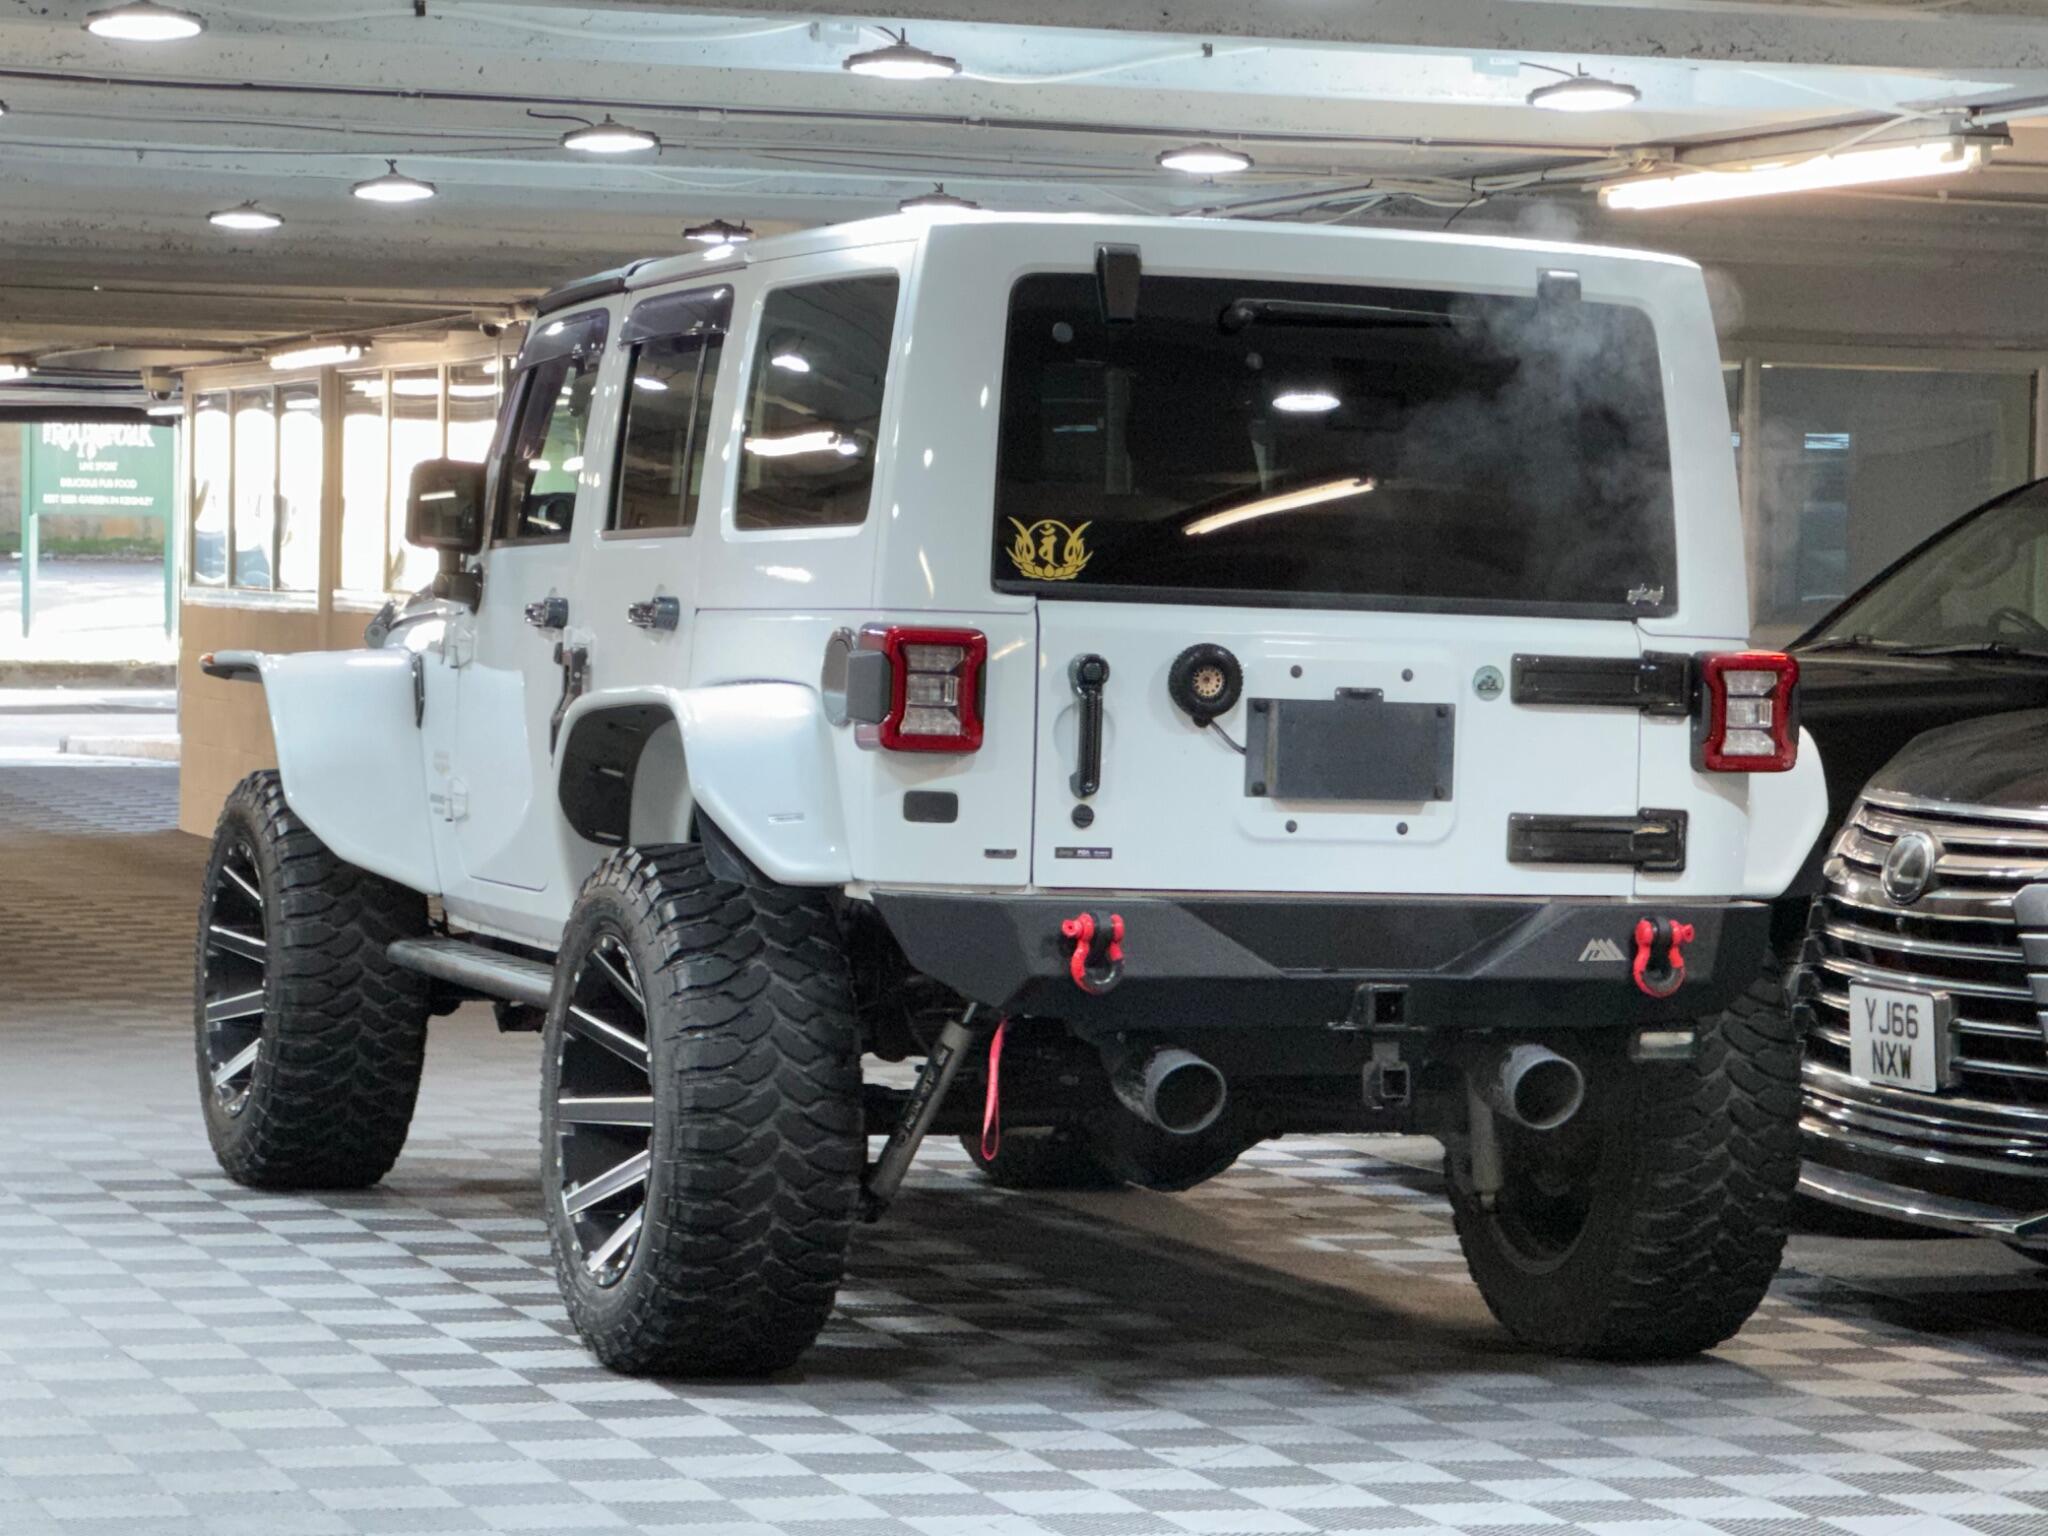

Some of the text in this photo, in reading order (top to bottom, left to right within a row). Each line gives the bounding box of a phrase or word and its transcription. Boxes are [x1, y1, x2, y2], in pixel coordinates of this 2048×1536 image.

[114, 478, 138, 490] FOOD
[1865, 997, 1918, 1039] YJ66
[1872, 1040, 1911, 1079] NXW
